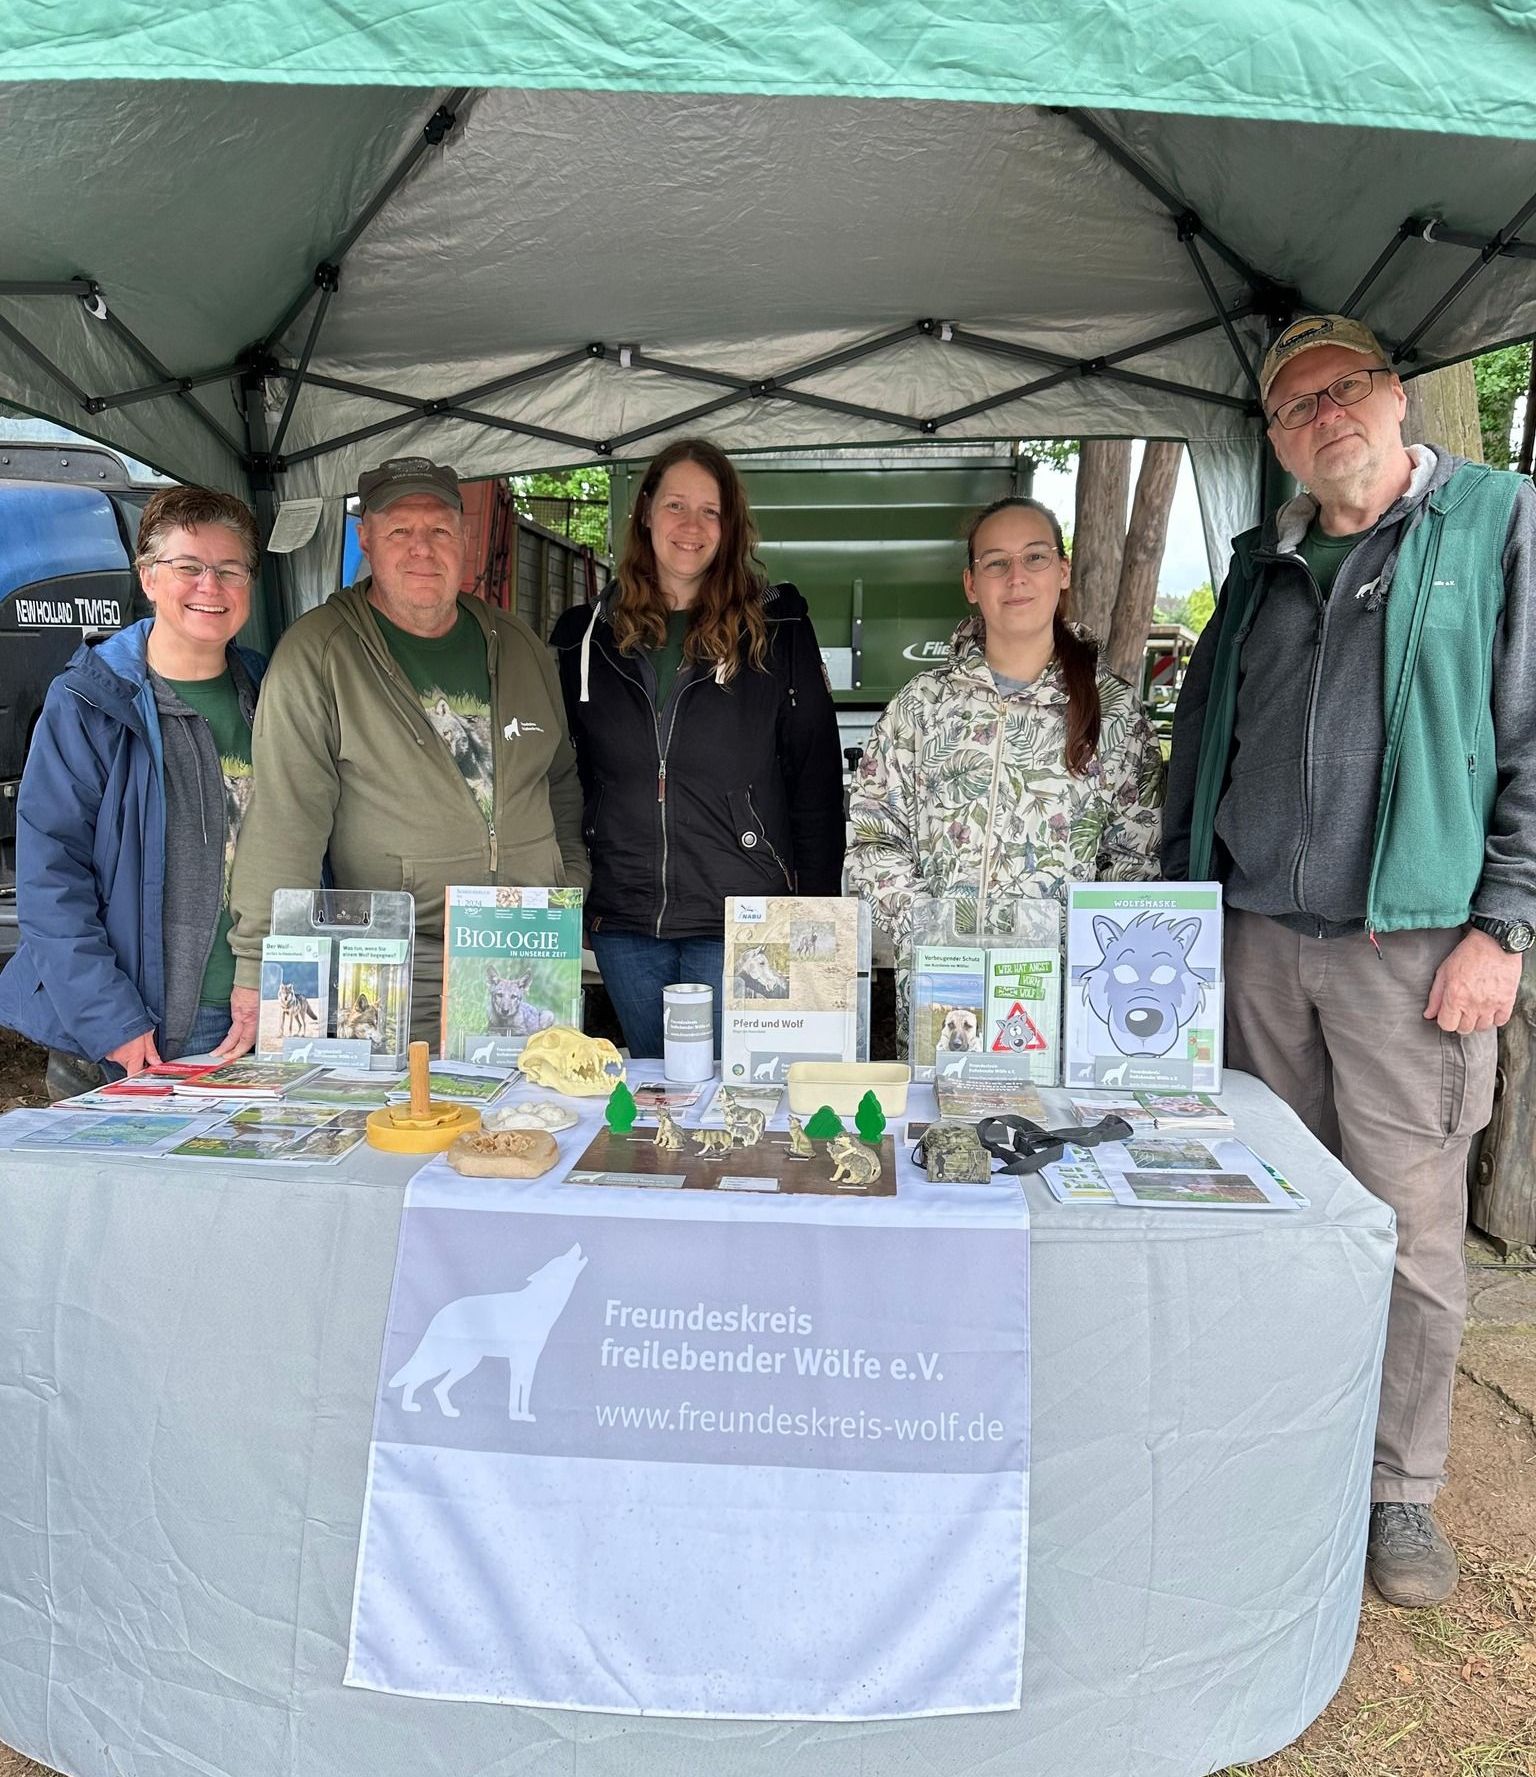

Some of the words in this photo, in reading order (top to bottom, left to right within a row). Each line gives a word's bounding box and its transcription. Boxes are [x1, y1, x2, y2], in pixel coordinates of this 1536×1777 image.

[16, 600, 35, 622] NEW
[36, 601, 72, 623] HOLLAND
[75, 598, 120, 624] TM150
[922, 641, 951, 656] Flie
[1114, 900, 1177, 908] WOLFSMASKE
[456, 926, 559, 949] BIOLOGIE
[925, 955, 961, 963] Vorbeugender
[733, 1019, 759, 1029] Pferd
[761, 1019, 780, 1028] und
[782, 1019, 804, 1028] Wolf
[604, 1300, 813, 1335] Freundeskreis
[600, 1338, 786, 1374] freilebender
[794, 1347, 881, 1379] Wölfe
[890, 1351, 944, 1381] e.V.
[595, 1401, 1005, 1442] www.freundeskreis-wolf.de
